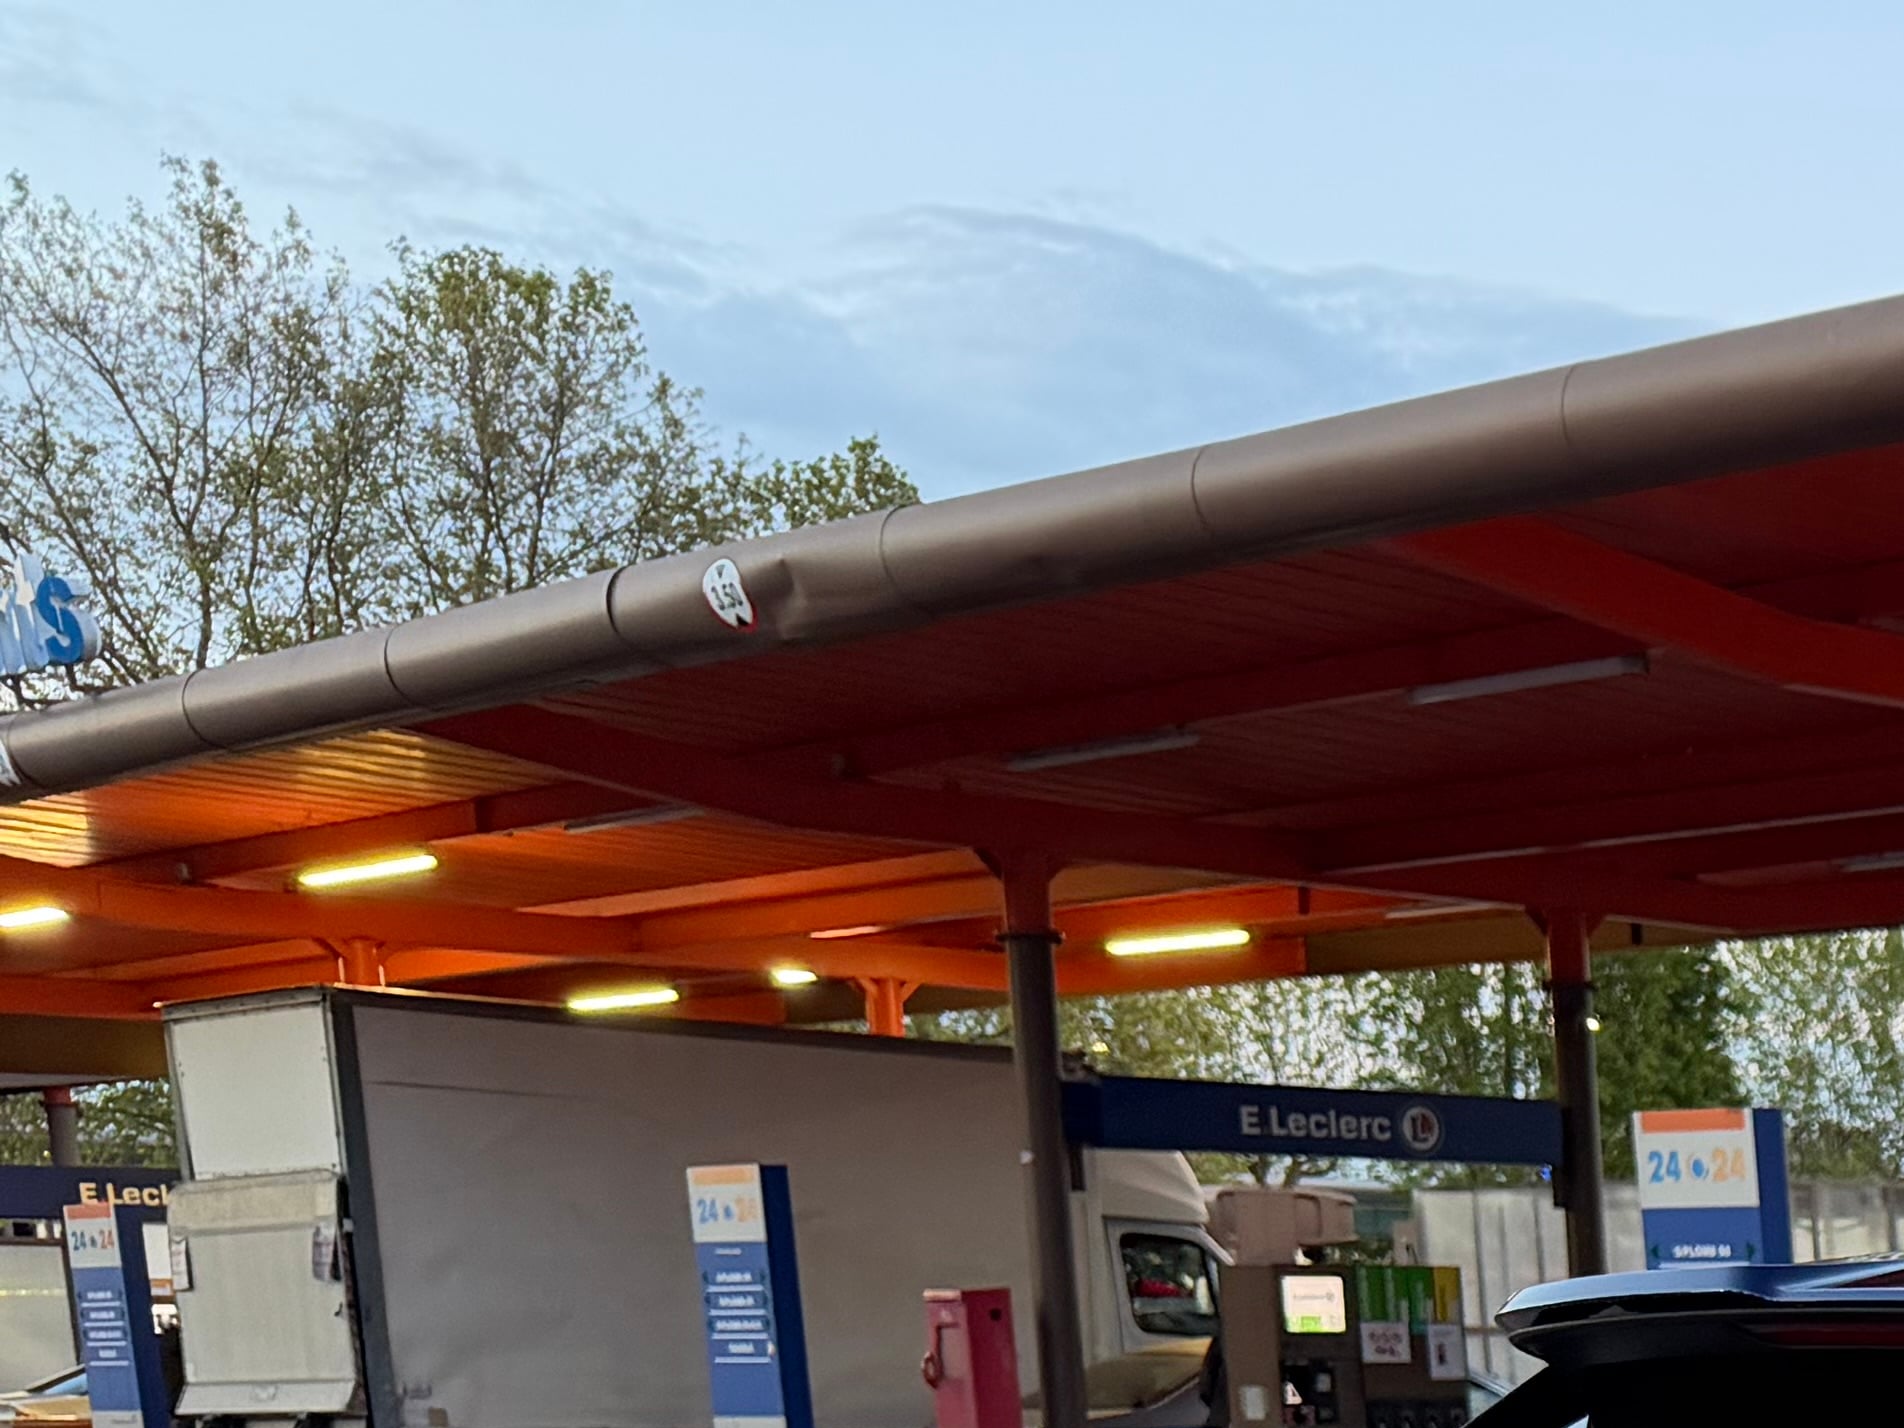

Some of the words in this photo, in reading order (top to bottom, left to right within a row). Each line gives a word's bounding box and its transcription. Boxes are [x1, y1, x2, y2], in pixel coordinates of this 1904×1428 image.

[1648, 1149, 1682, 1184] 24
[1711, 1148, 1746, 1184] 24
[697, 1198, 719, 1224] 24
[71, 1230, 87, 1251] 24
[100, 1229, 115, 1250] 24
